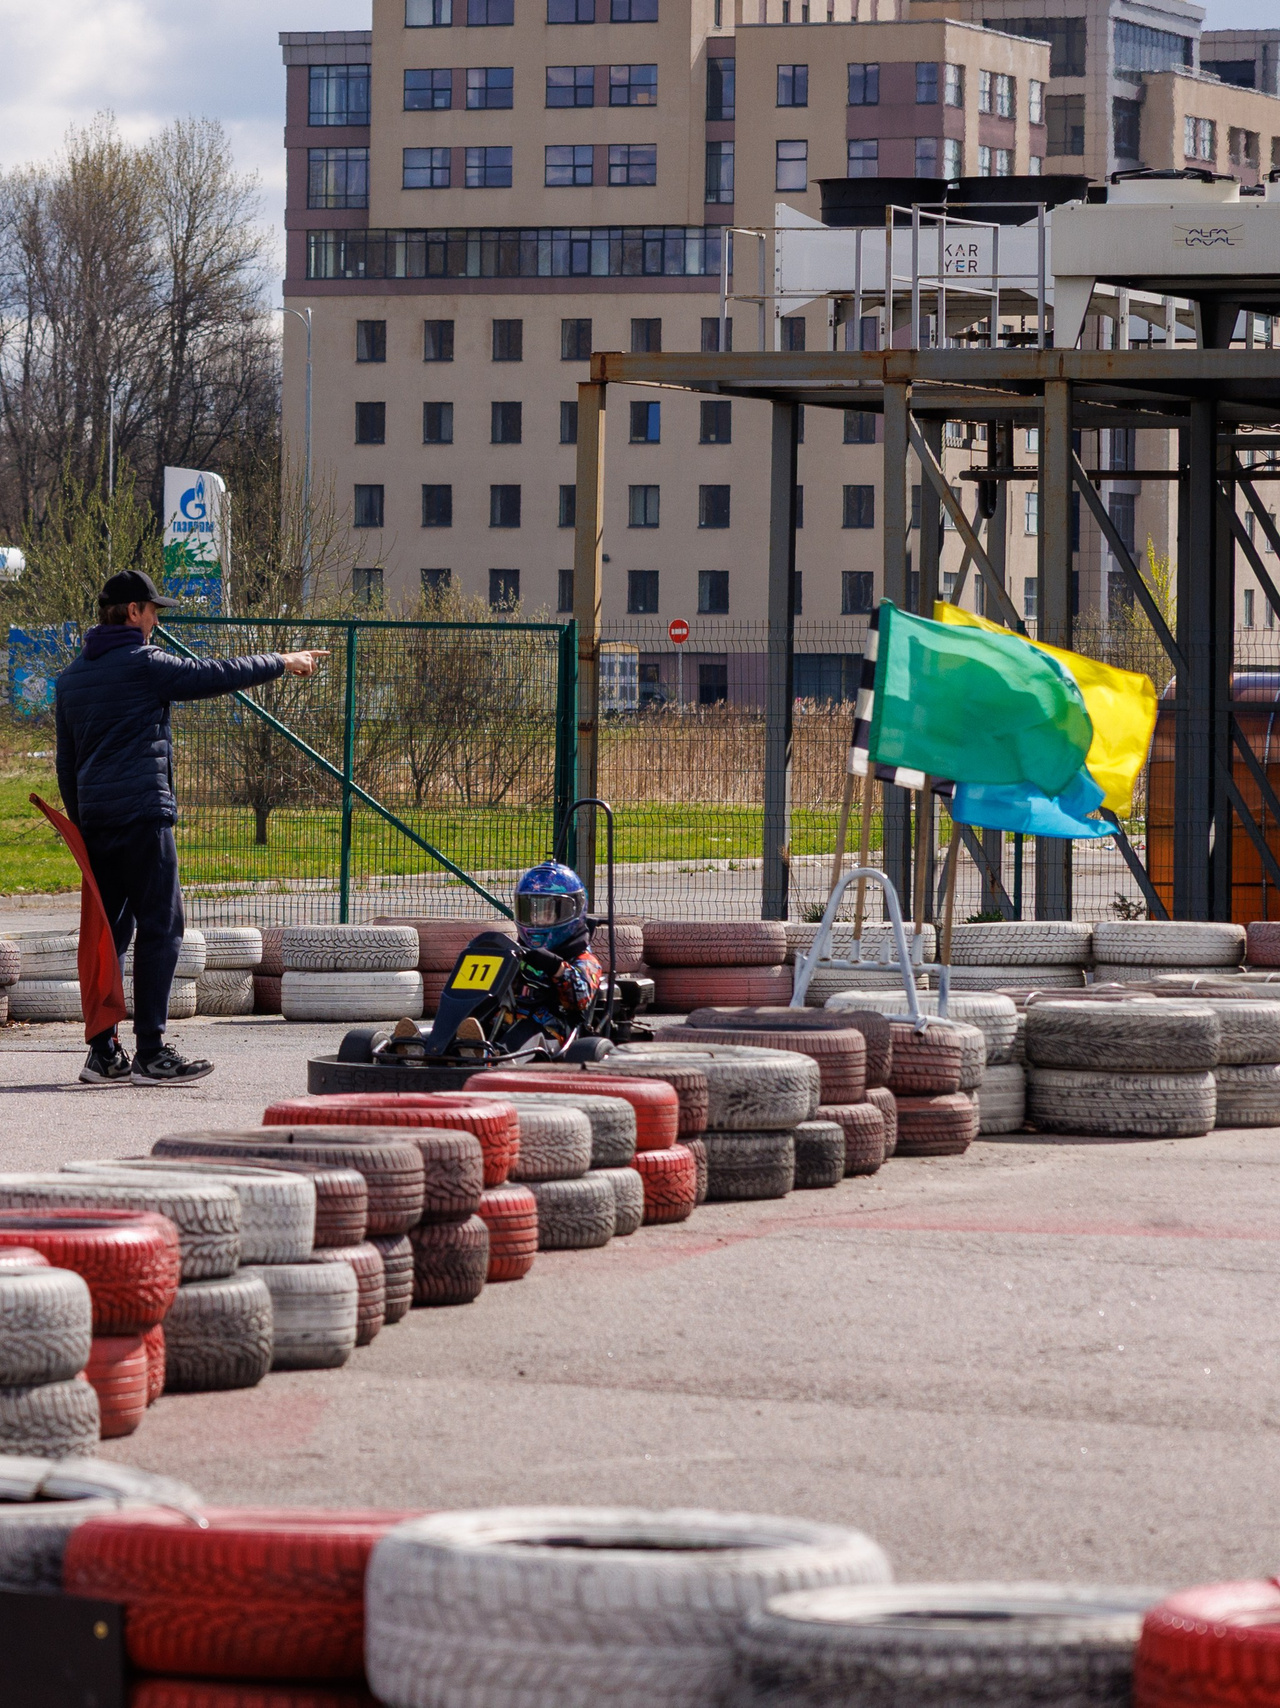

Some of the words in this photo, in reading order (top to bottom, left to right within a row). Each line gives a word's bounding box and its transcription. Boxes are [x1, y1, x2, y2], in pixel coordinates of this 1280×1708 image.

[1188, 228, 1228, 238] ALFA
[1185, 237, 1235, 246] LAVAL
[945, 244, 978, 257] KAR
[944, 260, 978, 273] YER
[172, 520, 215, 533] ГАЗПРОМ
[468, 963, 491, 982] 11
